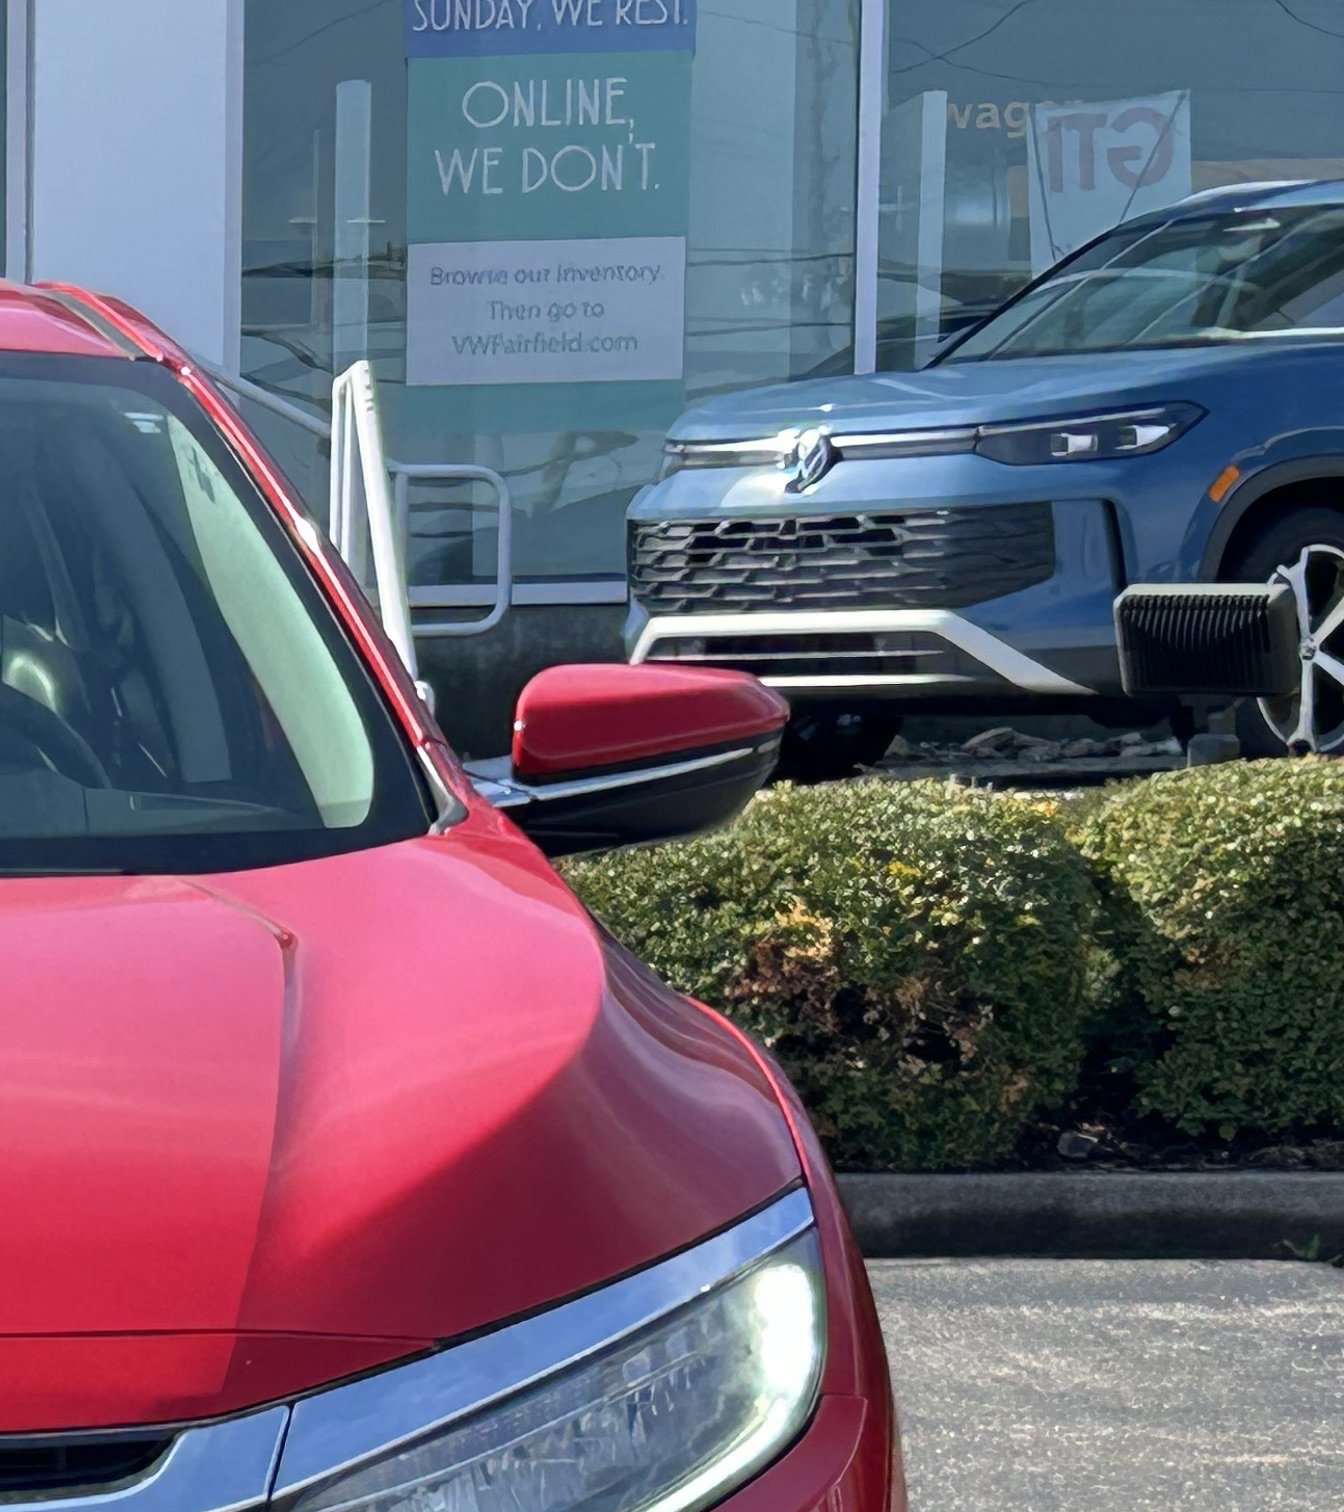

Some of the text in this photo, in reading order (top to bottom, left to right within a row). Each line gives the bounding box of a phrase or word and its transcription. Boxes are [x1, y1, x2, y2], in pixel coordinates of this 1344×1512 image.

[411, 0, 542, 31] SUNDAY,
[551, 0, 603, 26] WE
[462, 77, 635, 130] ONLINE,
[433, 134, 660, 195] WE DON'T.
[430, 266, 509, 286] Browse
[513, 268, 551, 284] our
[488, 300, 606, 322] Then go to
